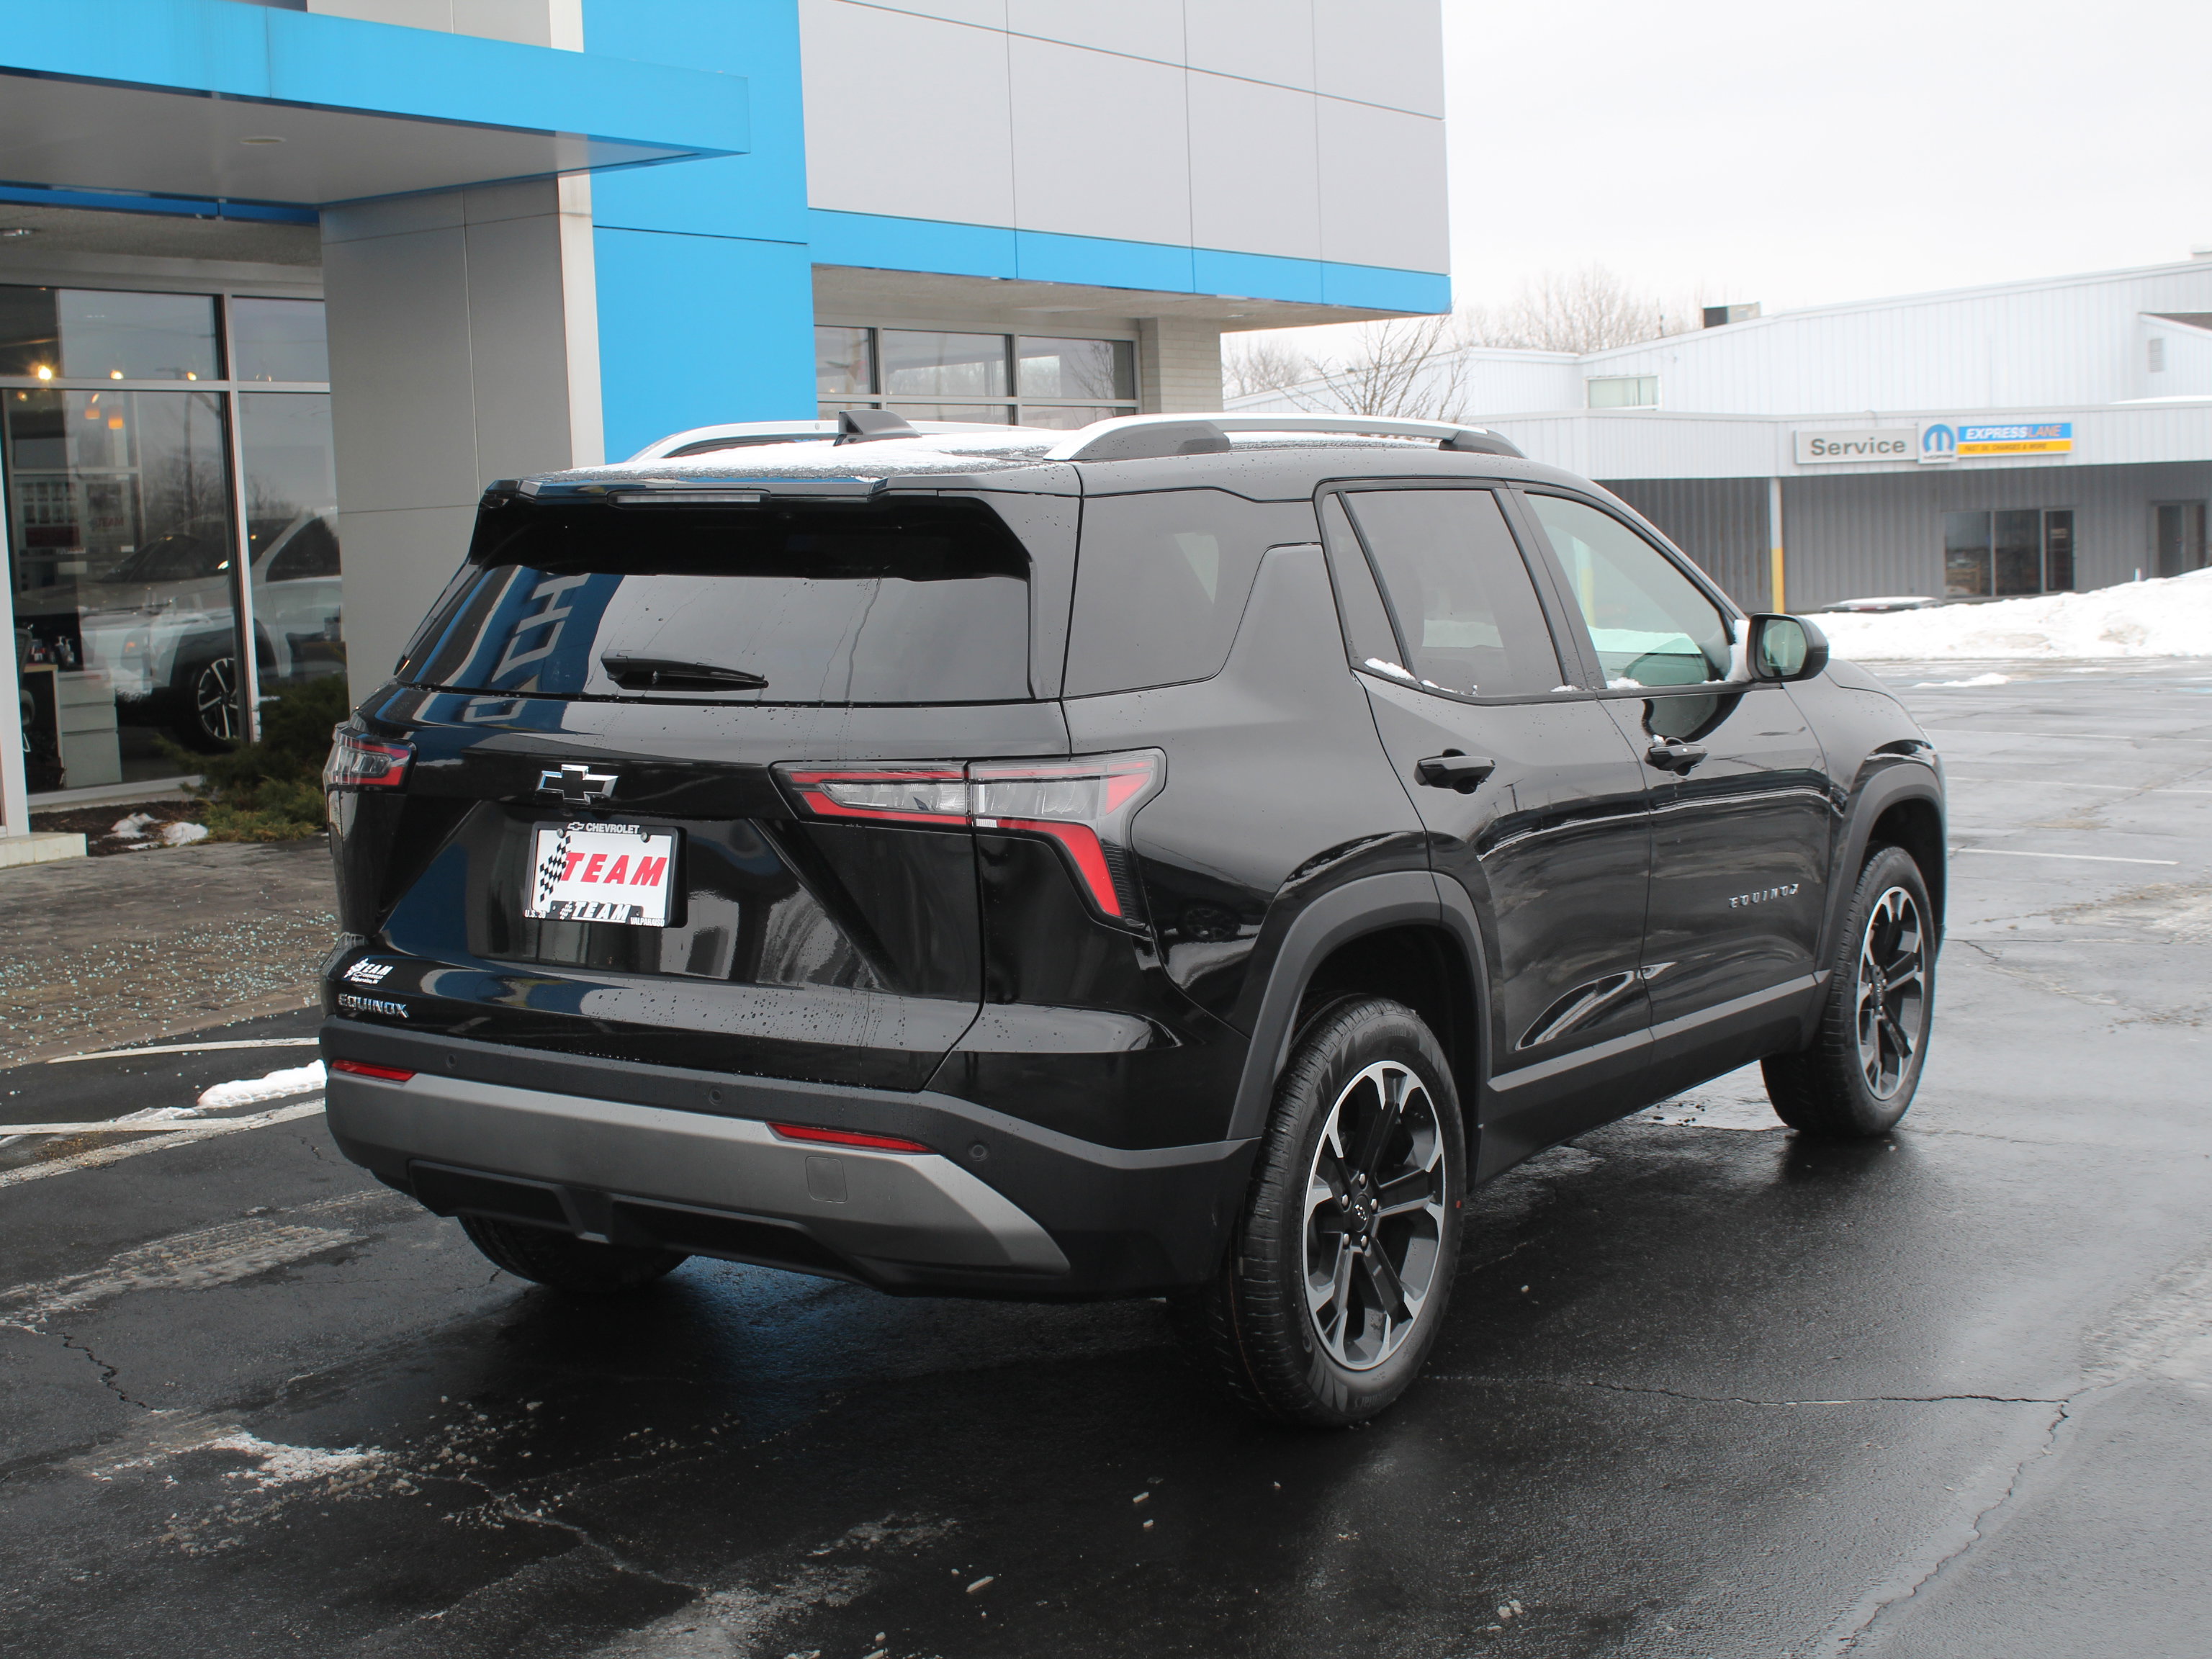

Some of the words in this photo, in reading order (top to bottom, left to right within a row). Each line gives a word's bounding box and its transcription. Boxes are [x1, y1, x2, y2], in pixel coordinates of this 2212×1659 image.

[1810, 436, 1907, 456] Service
[586, 823, 639, 834] CHEVROLET
[561, 853, 667, 886] TEAM
[1729, 884, 1799, 908] EQUINOX
[572, 901, 631, 921] TEAM
[630, 917, 665, 927] VALPARAISO
[338, 993, 409, 1018] EQUINOX
